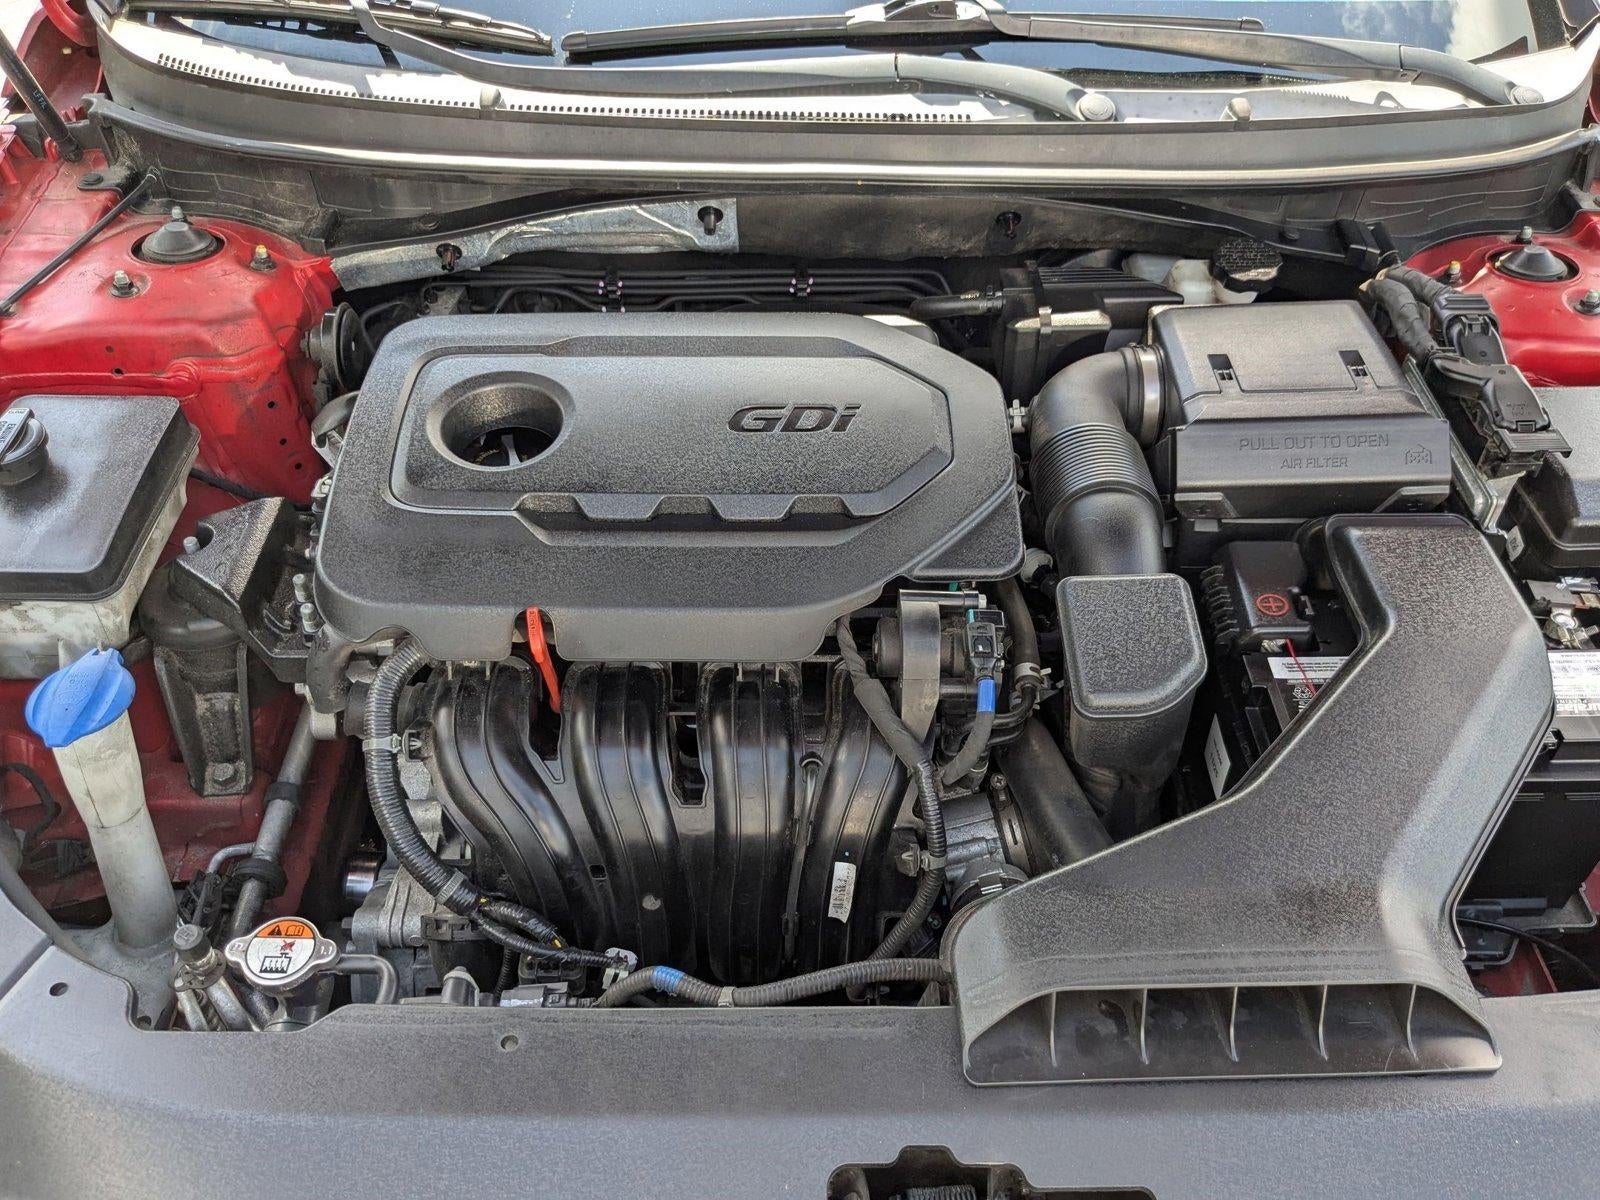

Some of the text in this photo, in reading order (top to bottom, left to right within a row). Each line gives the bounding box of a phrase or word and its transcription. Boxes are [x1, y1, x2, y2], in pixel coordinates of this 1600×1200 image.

[727, 403, 862, 433] GDi
[1238, 433, 1389, 451] PULL OUT TO OPEN
[1280, 456, 1349, 470] AIR FILTER
[320, 945, 333, 956] 1.1
